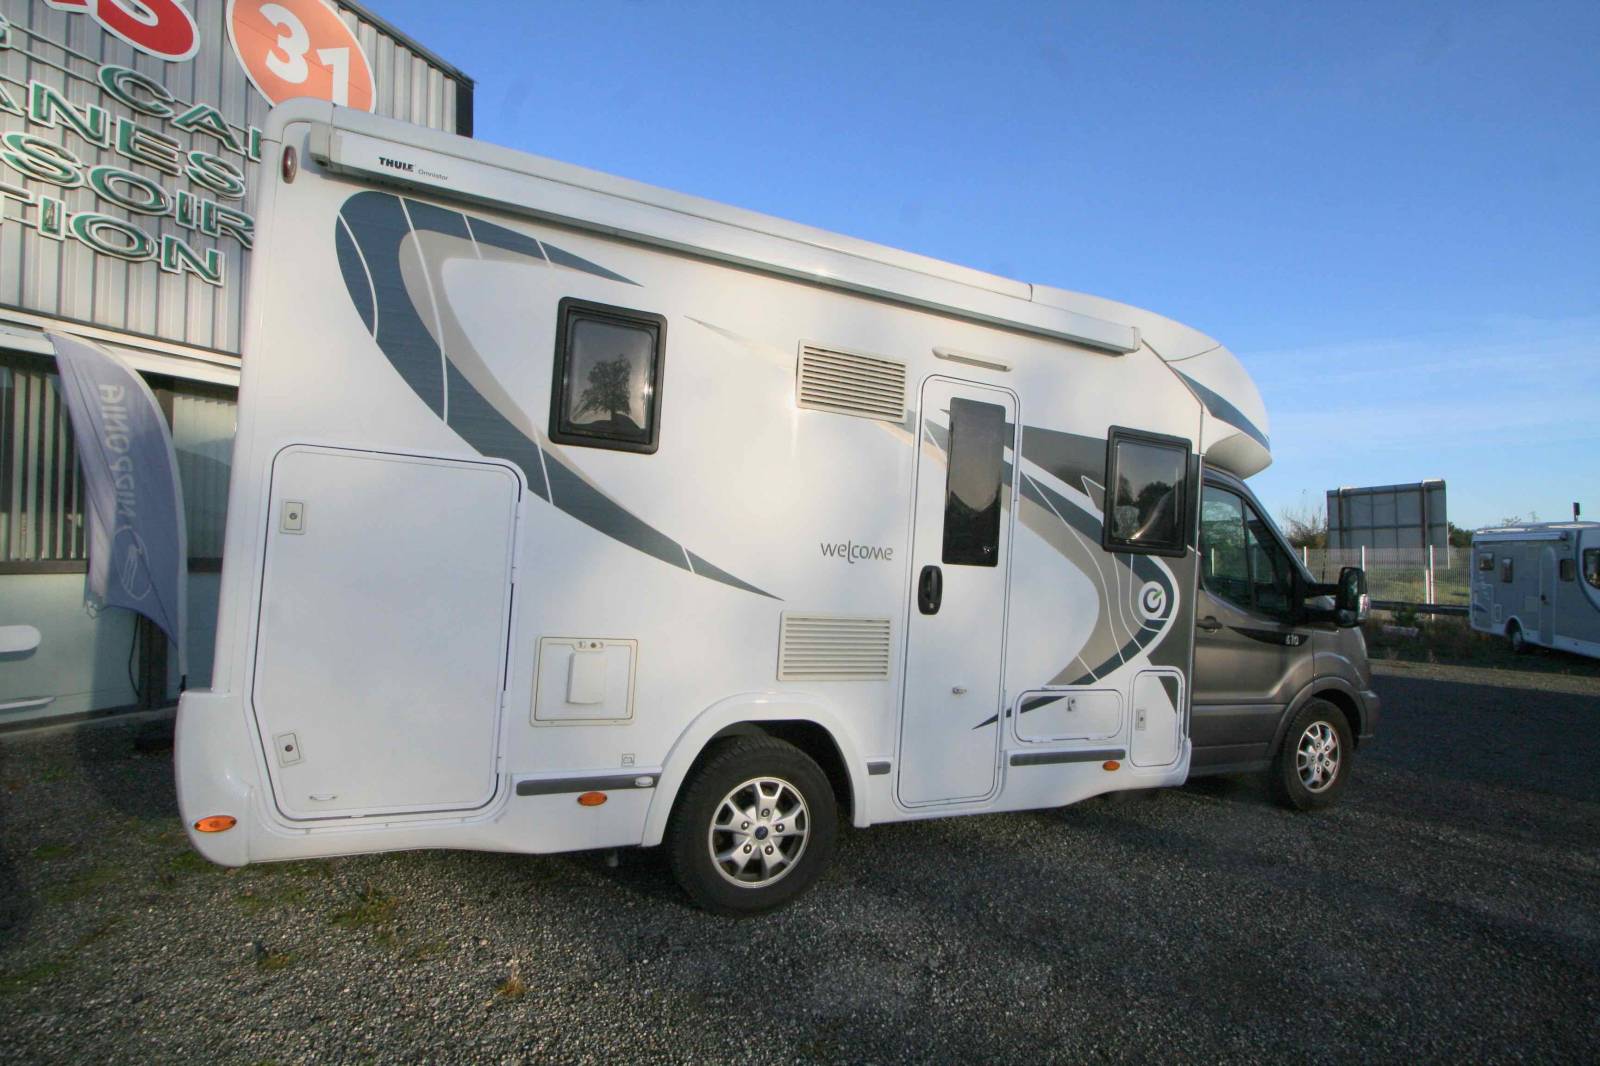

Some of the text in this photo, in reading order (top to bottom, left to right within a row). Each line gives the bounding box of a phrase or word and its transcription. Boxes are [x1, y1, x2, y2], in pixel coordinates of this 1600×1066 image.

[258, 3, 350, 106] 31
[378, 156, 414, 172] THULE
[820, 539, 894, 564] welcome
